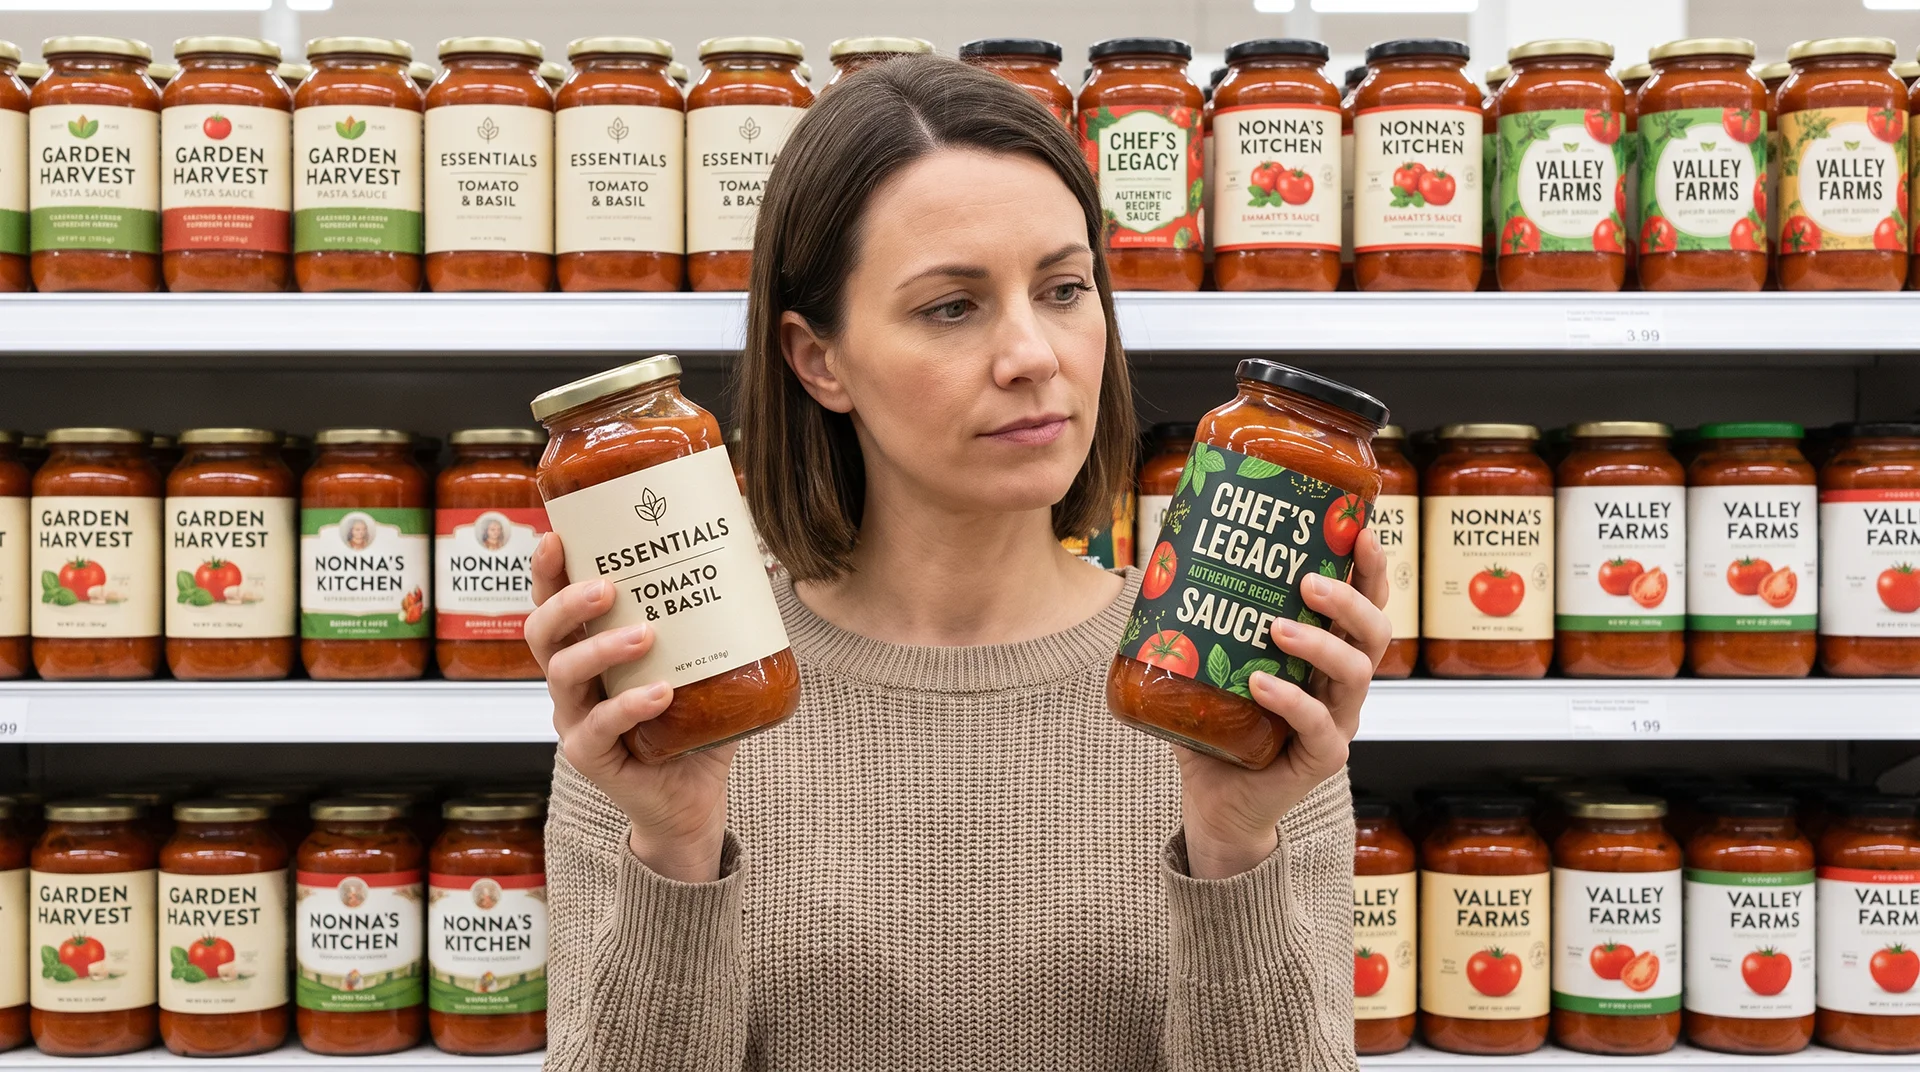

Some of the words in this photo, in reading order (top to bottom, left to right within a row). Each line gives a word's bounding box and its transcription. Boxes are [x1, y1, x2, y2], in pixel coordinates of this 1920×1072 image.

[1238, 120, 1324, 136] NONNA'S
[1380, 121, 1465, 137] NONNA'S
[1110, 132, 1177, 150] CHEF'S
[1241, 138, 1322, 155] KITCHEN
[1382, 139, 1464, 155] KITCHEN
[43, 146, 131, 163] GARDEN
[176, 146, 264, 163] GARDEN
[309, 147, 397, 164] GARDEN
[441, 152, 537, 168] ESSENTIALS
[571, 153, 667, 168] ESSENTIALS
[703, 153, 780, 167] ESSENTIA
[1107, 153, 1179, 171] LEGACY
[40, 167, 136, 185] HARVEST
[173, 167, 269, 185] HARVEST
[307, 167, 401, 186] HARVEST
[1536, 160, 1604, 180] VALLEY
[1673, 160, 1741, 179] VALLEY
[1816, 159, 1885, 178] VALLEY
[50, 189, 81, 199] PASTA
[85, 189, 121, 199] SAUCE
[184, 189, 214, 199] PASTA
[219, 189, 254, 199] SAUCE
[458, 181, 519, 192] TOMATO
[588, 181, 649, 192] TOMATO
[719, 180, 768, 191] TOMAT
[1539, 182, 1602, 202] FARMS
[1676, 182, 1739, 201] FARMS
[1819, 181, 1883, 201] FARMS
[317, 190, 347, 199] PASTA
[352, 190, 387, 199] SAUCE
[461, 195, 471, 207] &
[476, 195, 516, 207] BASIL
[591, 195, 601, 207] &
[606, 195, 645, 207] BASIL
[723, 195, 732, 206] &
[737, 195, 762, 206] BAS
[1115, 191, 1172, 200] AUTHENTIC
[1125, 201, 1161, 211] RECIPE
[1126, 212, 1160, 221] SAUCE
[1292, 213, 1320, 222] SAUCE
[1434, 213, 1462, 223] SAUCE
[1627, 329, 1660, 342] 3.99
[42, 510, 129, 526] GARDEN
[1210, 482, 1315, 545] CHEF'S
[1451, 509, 1541, 525] NONNA'S
[1595, 502, 1671, 519] VALLEY
[1724, 502, 1801, 518] VALLEY
[1863, 508, 1919, 525] VALL
[177, 511, 264, 527] GARDEN
[40, 531, 133, 548] HARVEST
[1454, 530, 1540, 546] KITCHEN
[1598, 523, 1669, 540] FARMS
[1728, 523, 1799, 539] FARMS
[1867, 529, 1920, 546] FARM
[175, 532, 268, 548] HARVEST
[595, 517, 729, 575] ESSENTIALS
[1192, 518, 1308, 585] LEGACY
[315, 556, 404, 571] NONNA'S
[450, 556, 532, 571] NONNA'
[317, 576, 402, 591] KITCHEN
[631, 564, 717, 604] TOMATO
[1188, 564, 1247, 593] AUTHENTIC
[1248, 585, 1287, 607] RECIPE
[645, 605, 660, 621] &
[664, 586, 722, 616] BASIL
[1176, 587, 1276, 649] SAUCE
[675, 661, 693, 672] NEW
[695, 657, 708, 666] OZ
[1631, 720, 1661, 732] 1.99
[40, 886, 127, 903] GARDEN
[170, 887, 257, 904] GARDEN
[1353, 888, 1399, 905] LLEY
[1454, 888, 1533, 906] VALLEY
[1586, 887, 1664, 904] VALLEY
[1727, 891, 1802, 908] VALLEY
[1855, 888, 1920, 905] VALLE
[38, 907, 132, 925] HARVEST
[168, 908, 261, 926] HARVEST
[310, 912, 399, 930] NONNA'S
[443, 915, 532, 932] NONNA'S
[1354, 910, 1397, 927] RMS
[1457, 910, 1530, 927] FARMS
[1590, 908, 1662, 925] FARMS
[1731, 912, 1800, 929] FARMS
[1859, 909, 1919, 925] FARM
[312, 933, 398, 950] KITCHEN
[445, 935, 531, 952] KITCHEN
